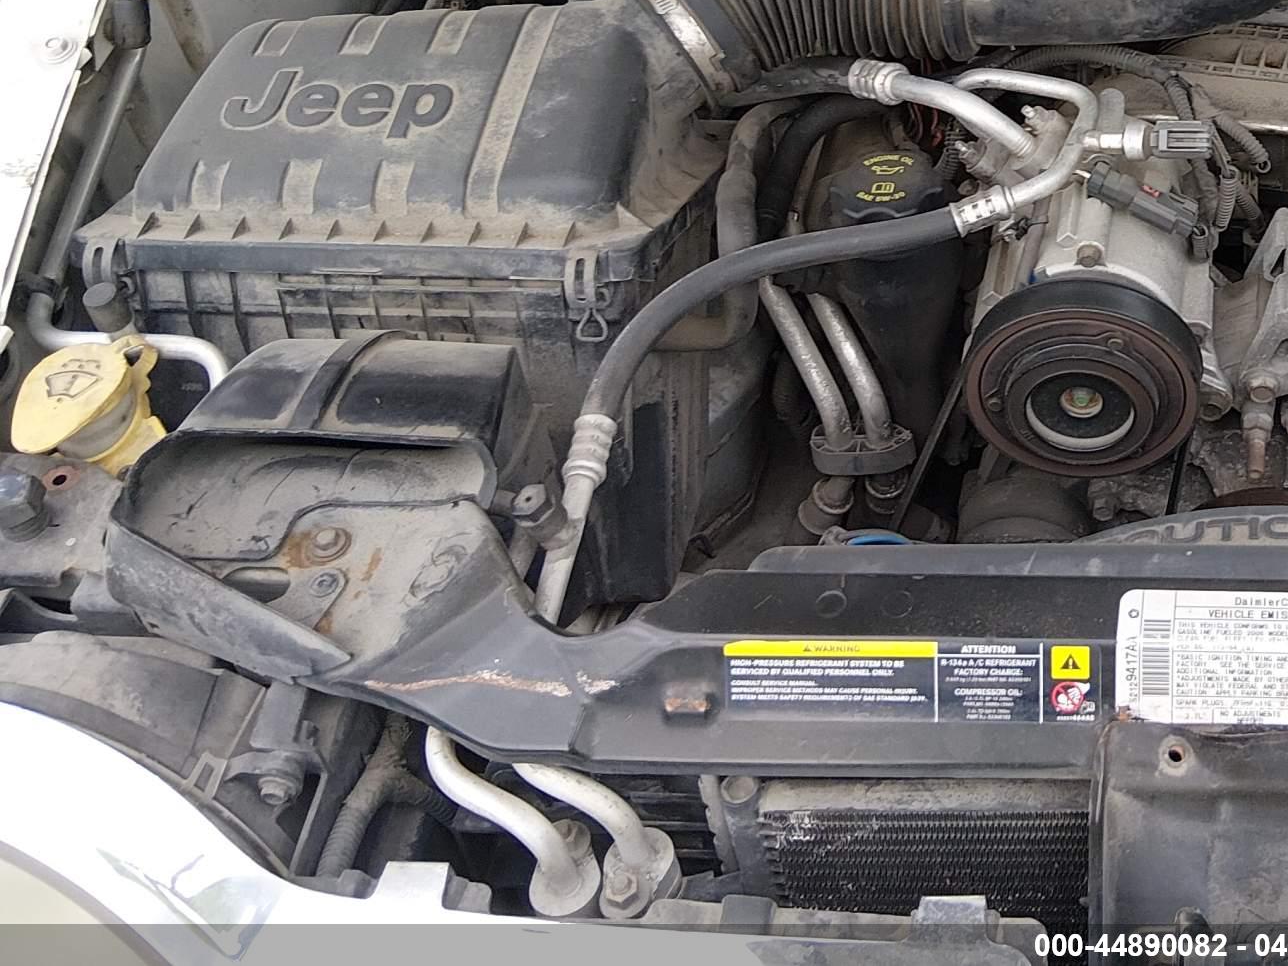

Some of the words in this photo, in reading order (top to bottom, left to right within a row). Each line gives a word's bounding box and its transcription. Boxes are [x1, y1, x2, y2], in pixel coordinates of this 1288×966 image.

[221, 68, 455, 141] Jeep
[863, 154, 901, 166] ENGINE
[900, 156, 914, 166] OIL
[1208, 609, 1254, 619] VEHICLE
[961, 645, 1017, 654] ATTENTION
[796, 660, 849, 668] REFRIGERANT
[850, 660, 881, 668] SYSTEM
[882, 660, 893, 668] TO
[894, 660, 904, 668] BE
[783, 668, 823, 676] QUALIFIED
[825, 668, 871, 676] PERSONNEL
[954, 668, 989, 676] FACTORY
[990, 668, 1024, 676] CHARGE:
[954, 688, 1006, 696] COMPRESSOR
